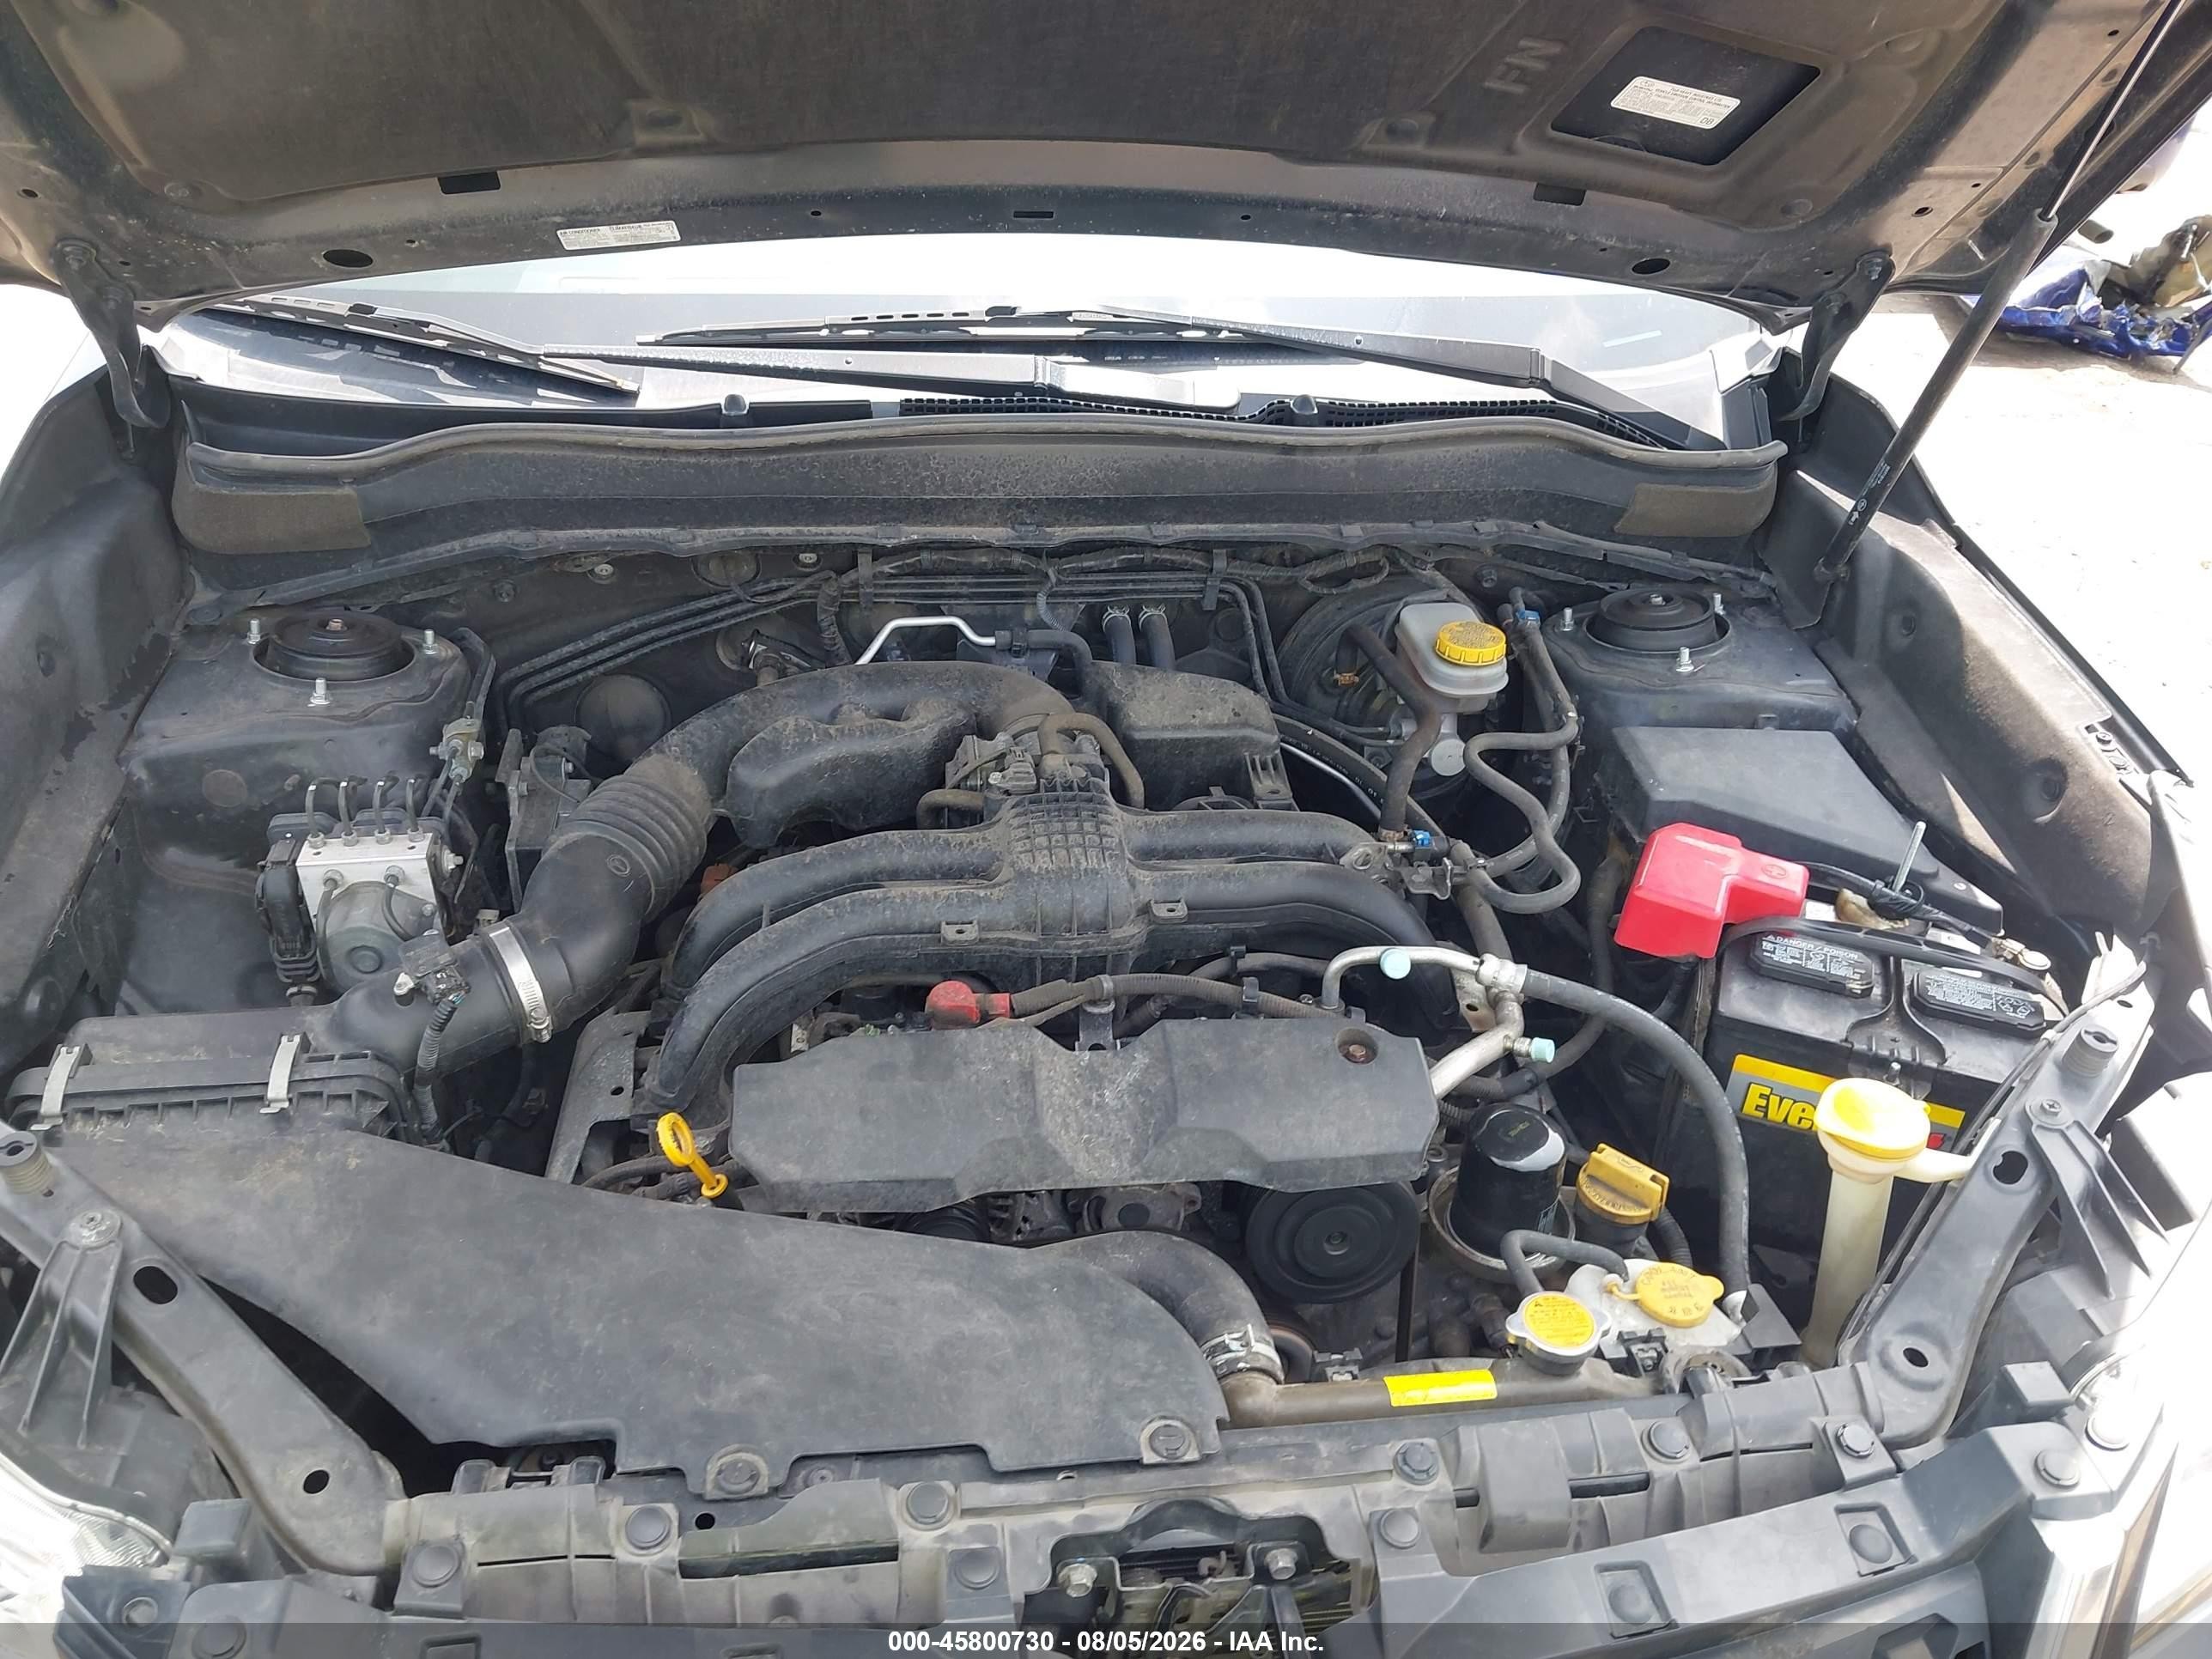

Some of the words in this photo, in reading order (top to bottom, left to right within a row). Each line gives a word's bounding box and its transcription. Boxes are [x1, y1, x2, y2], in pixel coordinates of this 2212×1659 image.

[1776, 936, 1814, 949] DANGER
[1823, 946, 1858, 960] POISON
[1741, 1082, 1818, 1132] Eve
